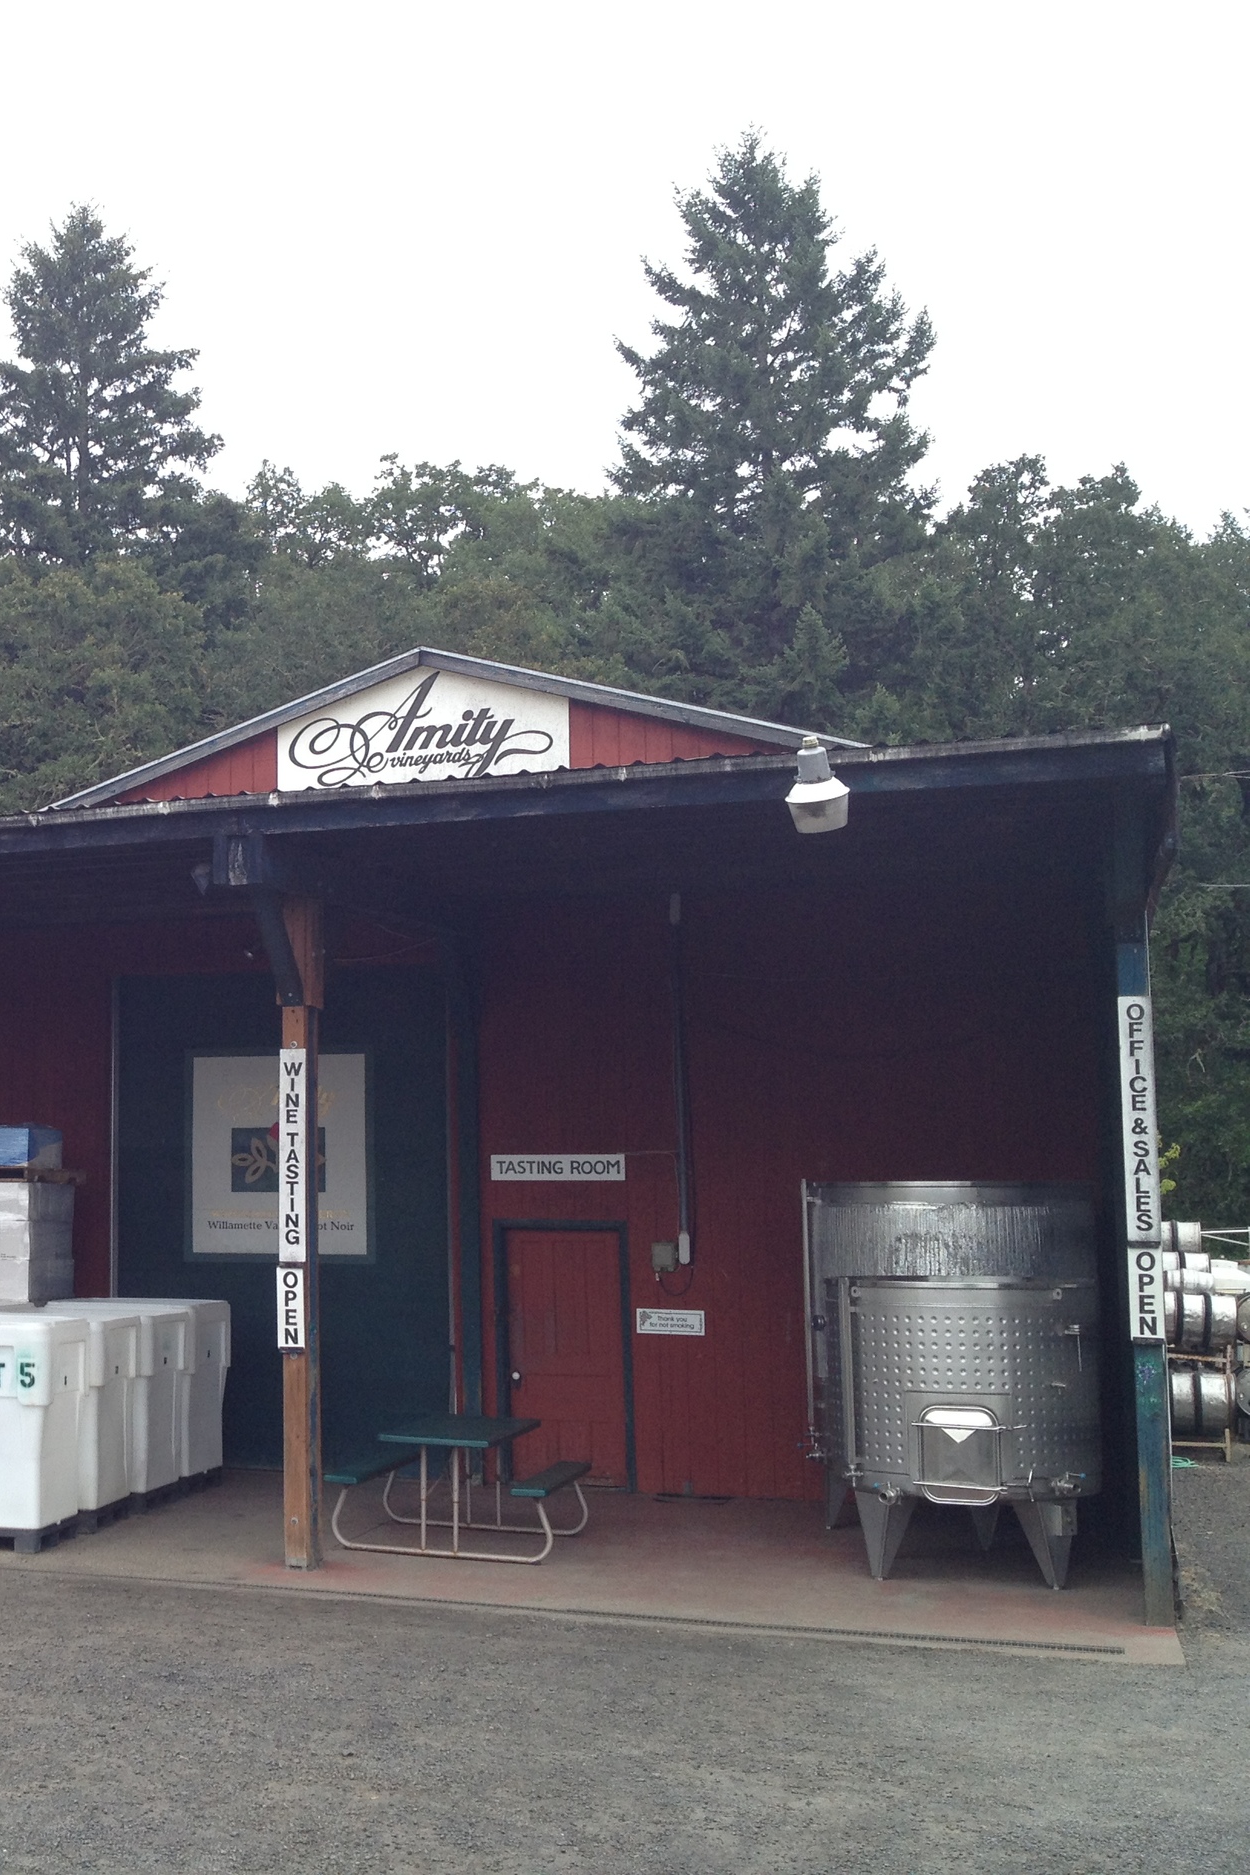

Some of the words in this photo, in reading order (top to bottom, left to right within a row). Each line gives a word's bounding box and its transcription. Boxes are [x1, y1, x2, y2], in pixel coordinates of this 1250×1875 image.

[289, 671, 554, 786] Amity
[390, 748, 472, 774] vineyards
[1125, 1003, 1148, 1112] OFFICE
[284, 1062, 303, 1124] WINE
[1131, 1117, 1149, 1135] &
[285, 1132, 300, 1246] TASTING
[496, 1160, 564, 1175] TASTING
[570, 1160, 621, 1175] ROOM
[1133, 1140, 1154, 1232] SALES
[207, 1220, 262, 1231] Willamette
[330, 1220, 355, 1231] Noir
[283, 1271, 299, 1345] OPEN
[1136, 1251, 1158, 1336] OPEN
[670, 1322, 695, 1330] smoking
[19, 1363, 36, 1389] 5
